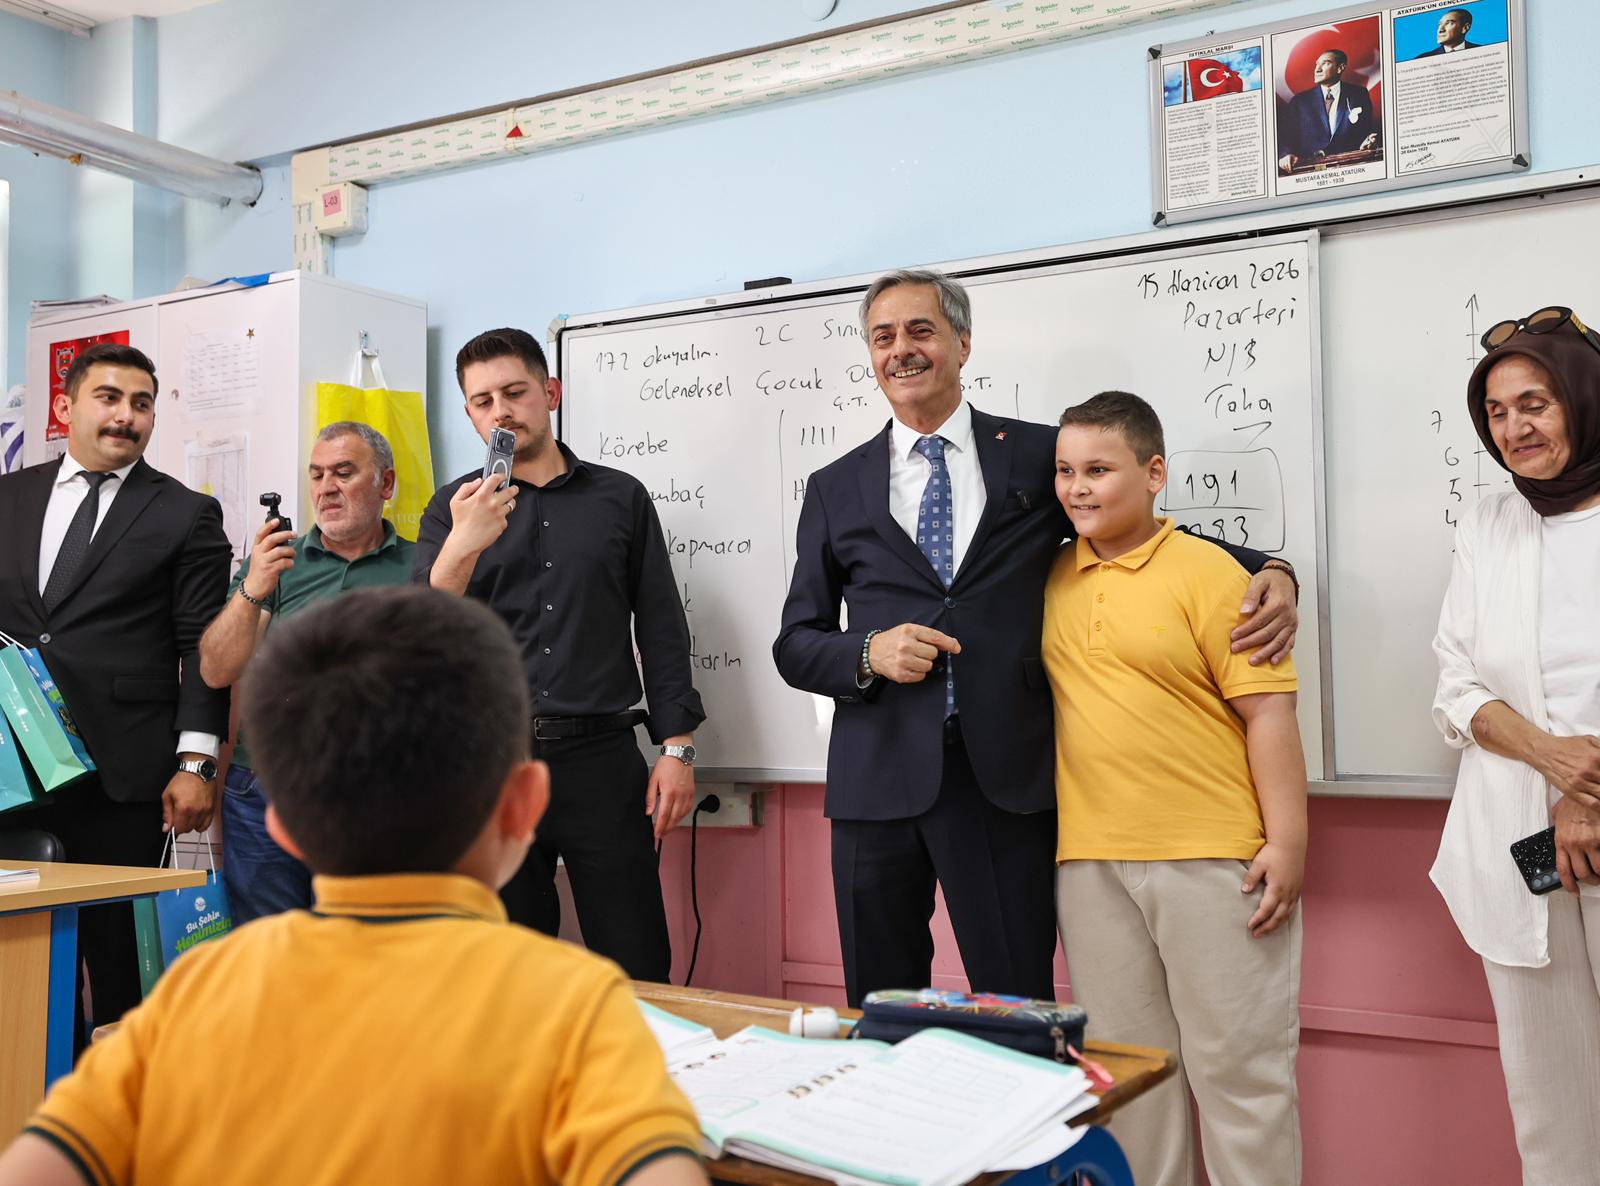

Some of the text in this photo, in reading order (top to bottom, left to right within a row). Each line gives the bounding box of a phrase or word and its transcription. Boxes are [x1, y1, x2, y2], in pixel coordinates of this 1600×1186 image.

[1296, 168, 1366, 184] MUSTAFA KEMAL ATATÜRK
[324, 195, 338, 208] L-03
[1167, 269, 1239, 296] Haziran
[1249, 258, 1300, 289] 2026
[1184, 296, 1297, 332] Pazartesi
[756, 318, 867, 346] 2 C Sını
[596, 352, 630, 372] 172
[640, 376, 732, 400] Geleneksel
[756, 368, 823, 395] Çocuk
[1204, 384, 1272, 418] Taha
[600, 432, 668, 460] Körebe
[1444, 446, 1460, 466] 6
[1186, 470, 1238, 506] 191
[1449, 478, 1462, 502] 5
[1446, 508, 1457, 528] 4
[186, 922, 198, 934] Bu
